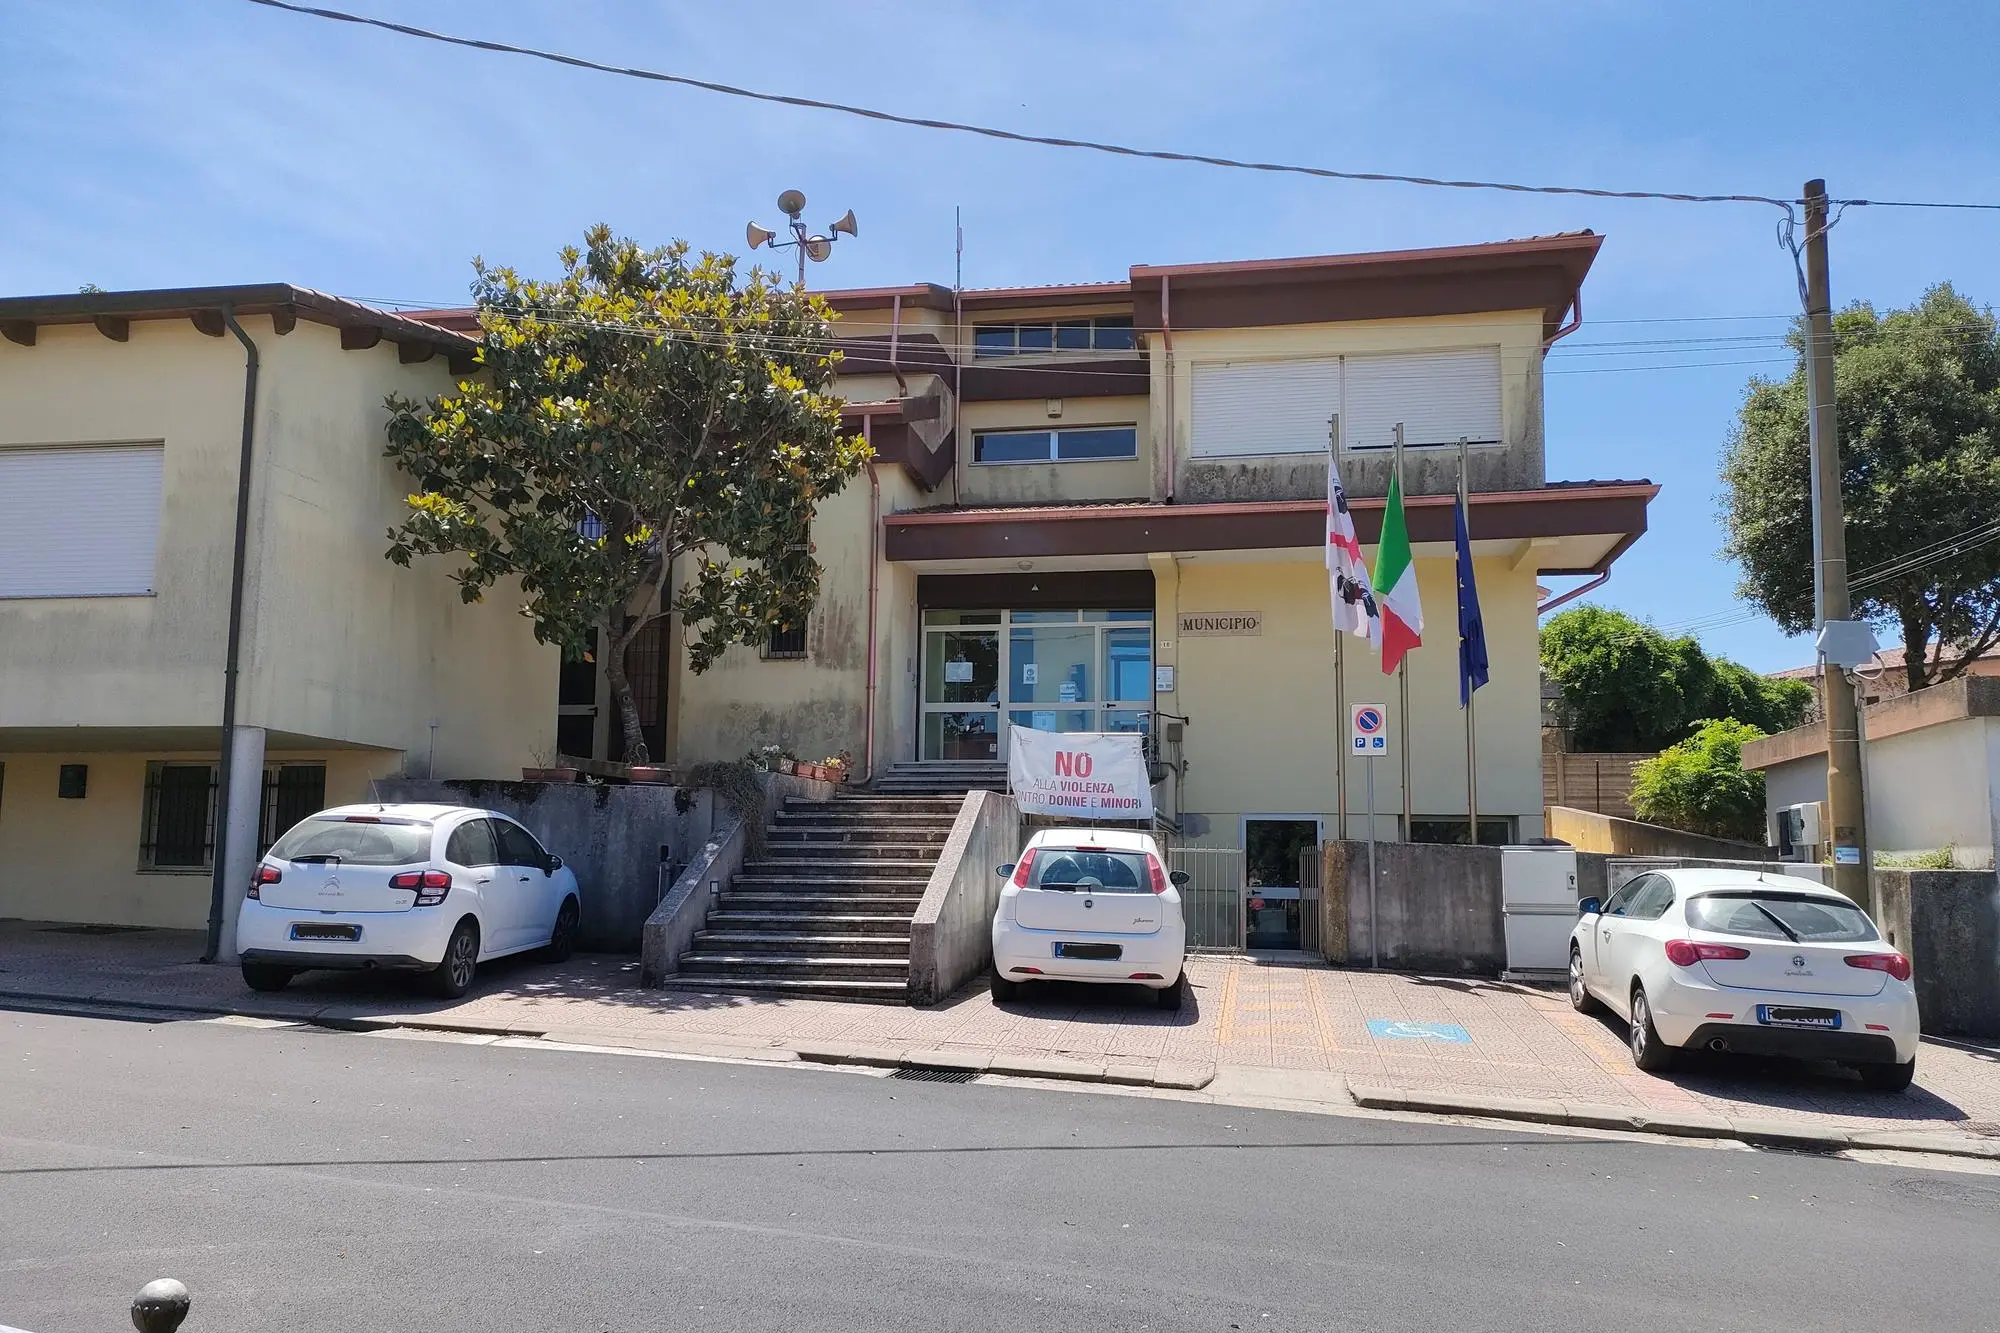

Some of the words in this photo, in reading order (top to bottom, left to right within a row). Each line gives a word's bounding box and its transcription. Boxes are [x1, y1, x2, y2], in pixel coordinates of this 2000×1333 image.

[1183, 617, 1256, 631] MUNICIPIO
[1357, 738, 1364, 747] P
[1055, 751, 1093, 778] NO
[1032, 778, 1057, 791] ALLA
[1060, 780, 1115, 794] VIOLENZA
[1015, 789, 1045, 805] ONTRO
[1049, 795, 1087, 808] DONNE
[1090, 797, 1097, 808] E
[1101, 797, 1142, 809] MINORI
